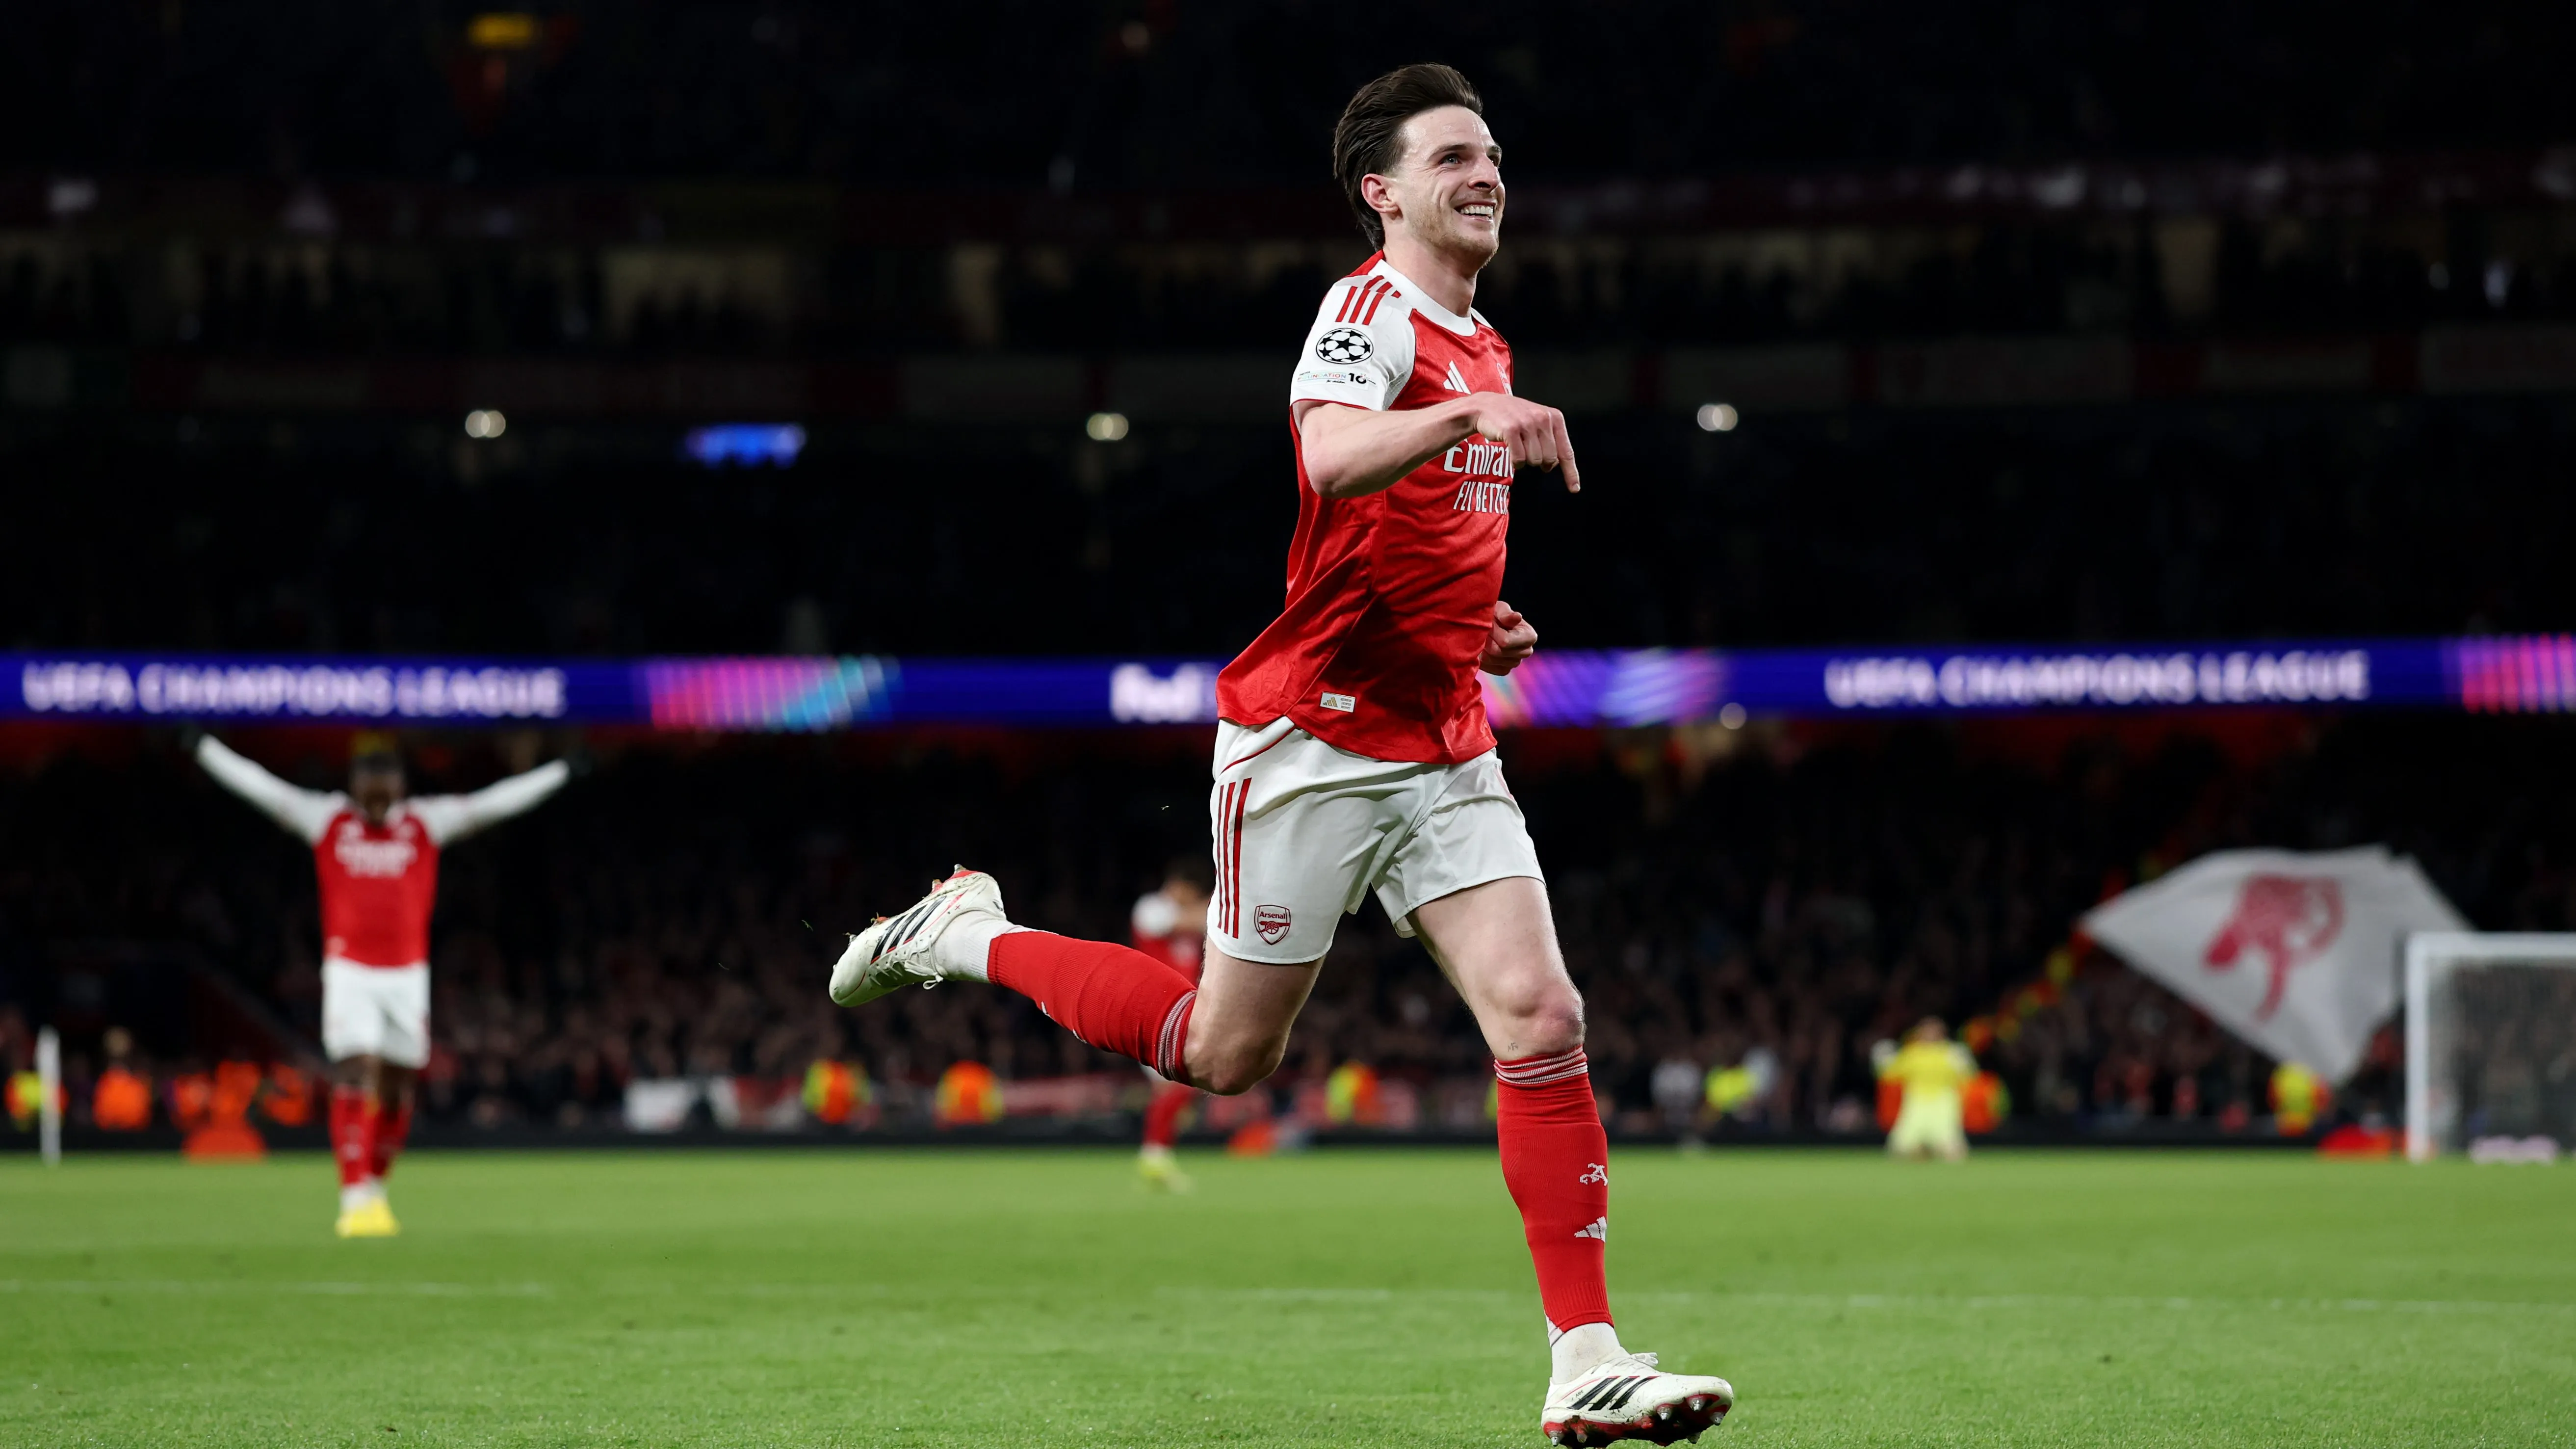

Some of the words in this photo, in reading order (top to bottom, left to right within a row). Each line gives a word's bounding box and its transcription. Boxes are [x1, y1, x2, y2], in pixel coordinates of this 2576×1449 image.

[1444, 438, 1514, 479] Emirat
[1453, 481, 1476, 511] FLY
[23, 661, 134, 711] UEFA
[138, 663, 393, 714] CHAMPIONS
[396, 666, 566, 717] LEAGUE
[1110, 662, 1218, 722] Fed
[1824, 658, 1938, 708] UEFA
[1939, 654, 2198, 707] CHAMPIONS
[2199, 650, 2369, 703] LEAGUE
